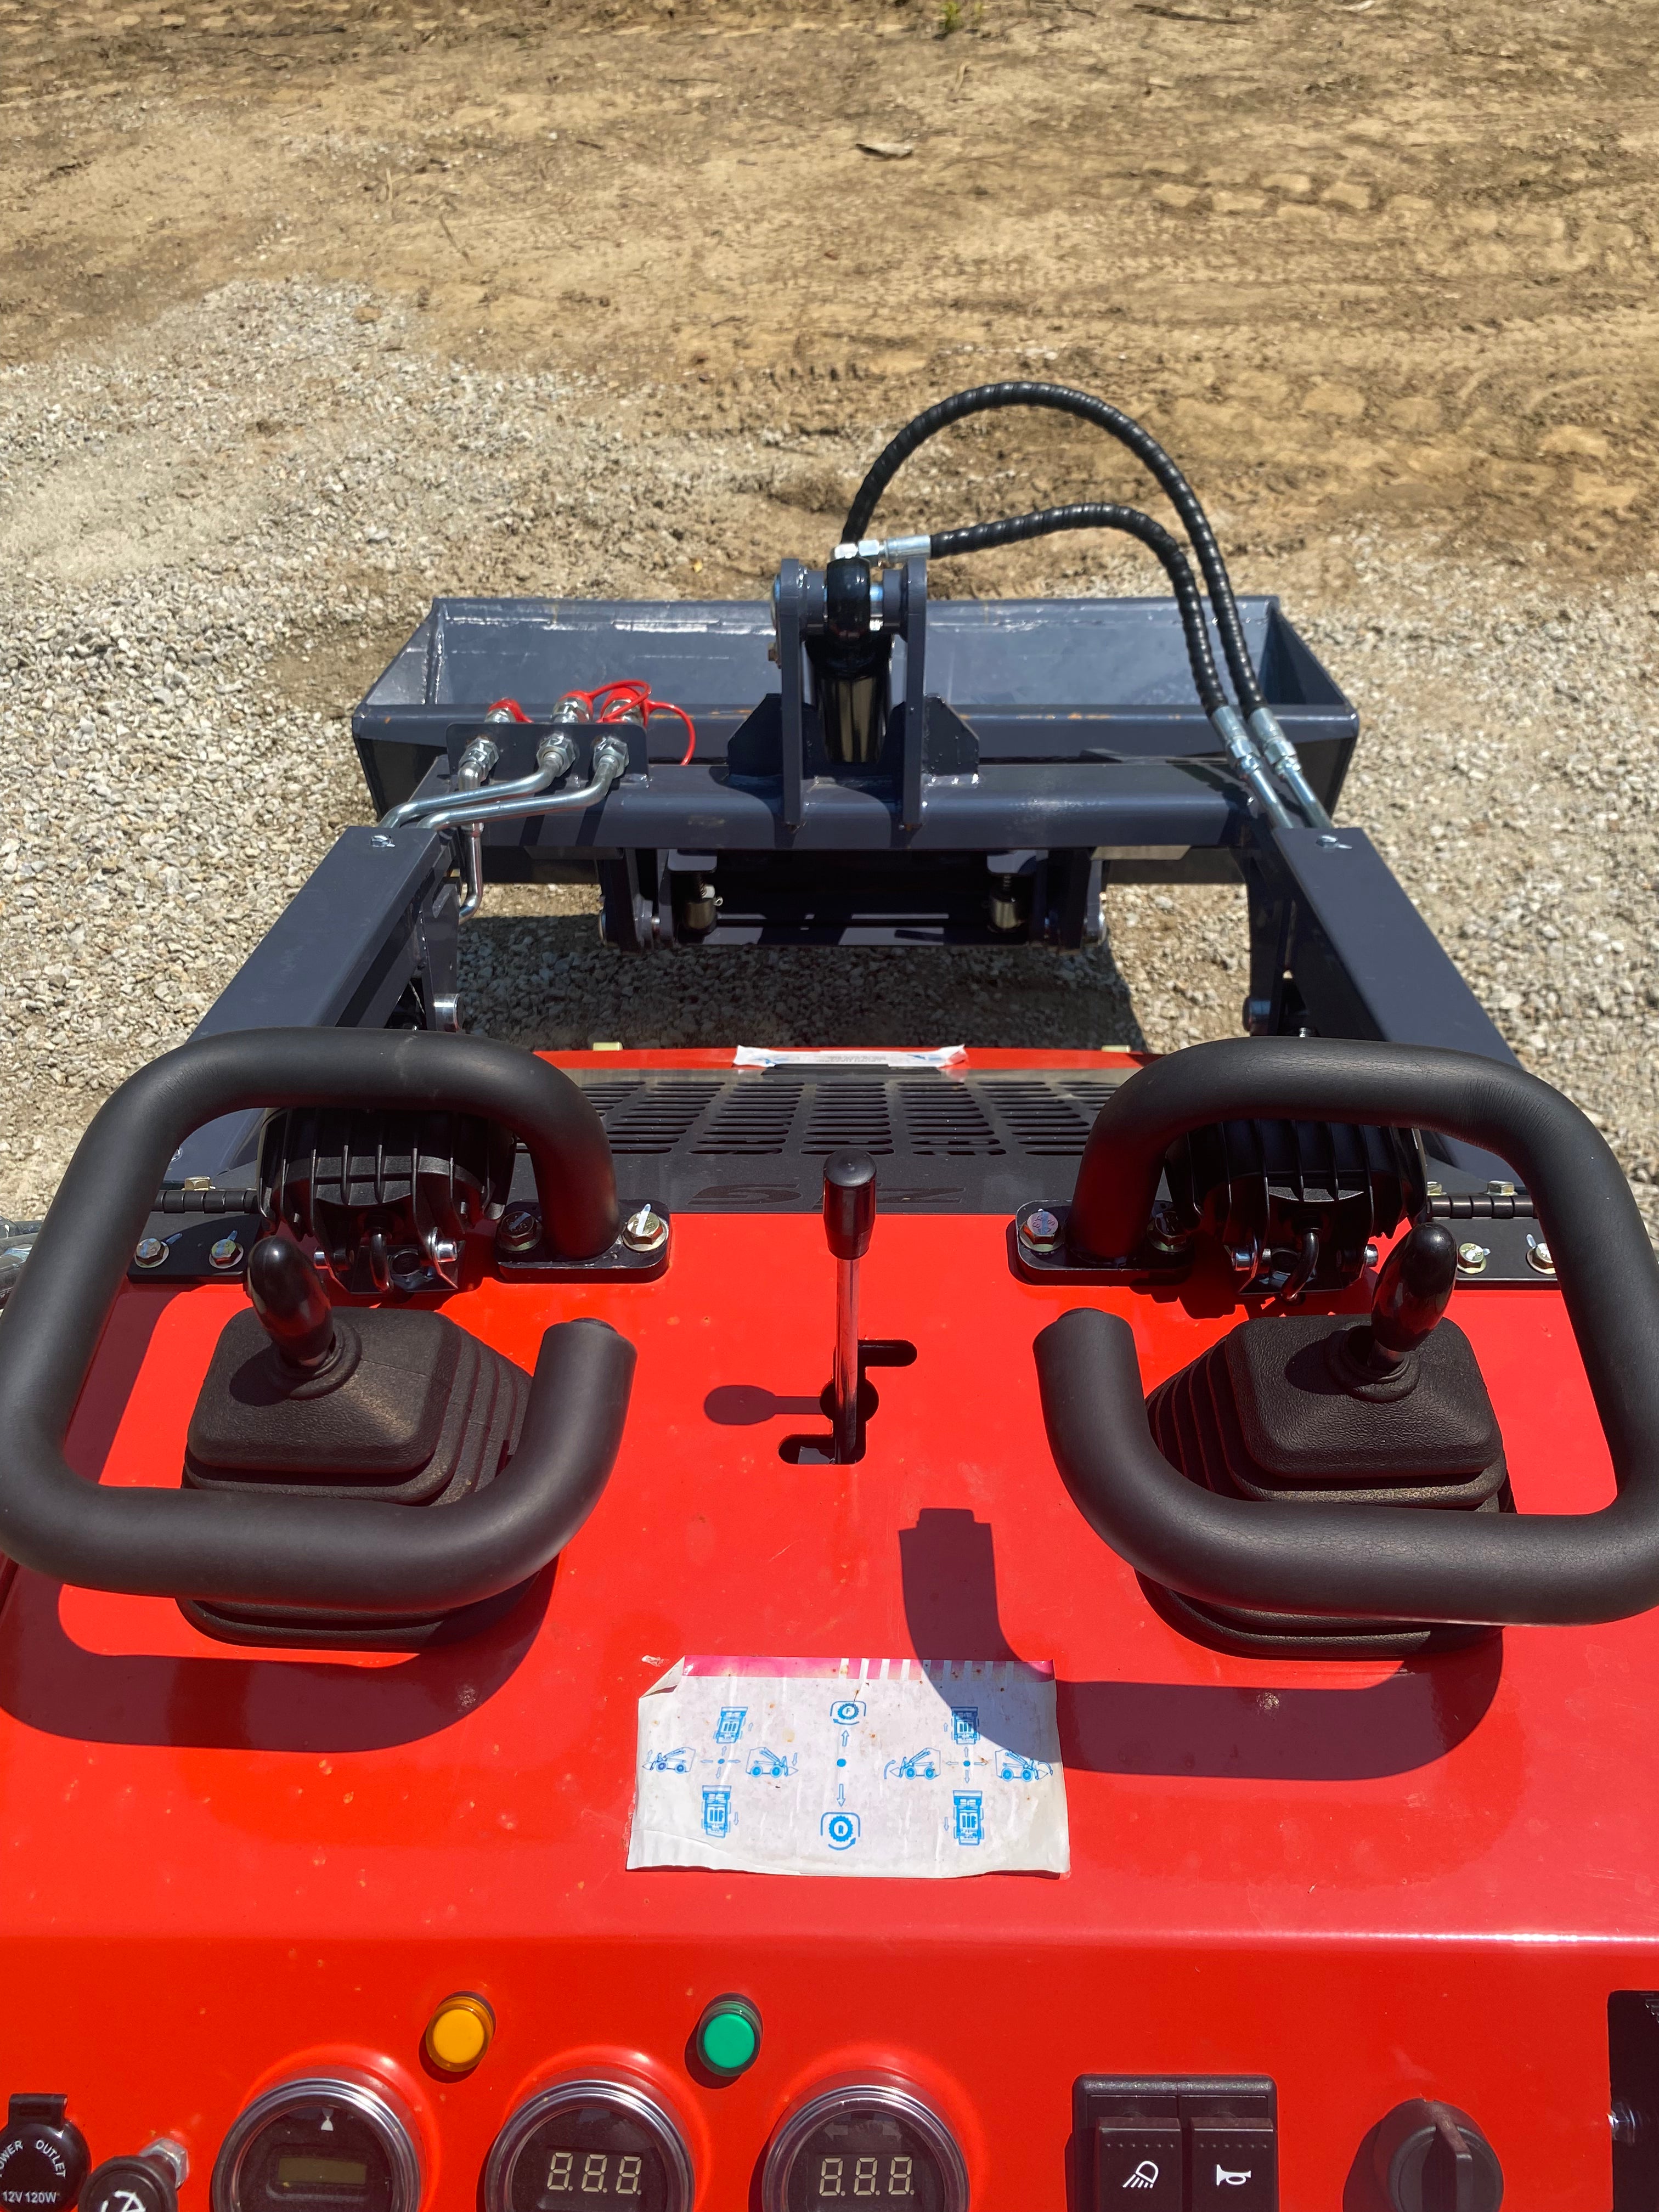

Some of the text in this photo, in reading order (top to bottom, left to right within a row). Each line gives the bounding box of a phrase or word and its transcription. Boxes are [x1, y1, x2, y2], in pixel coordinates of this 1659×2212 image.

[838, 1824, 844, 1835] R
[0, 2140, 66, 2179] OWER OUTLET
[3, 2190, 57, 2204] 12V 120W
